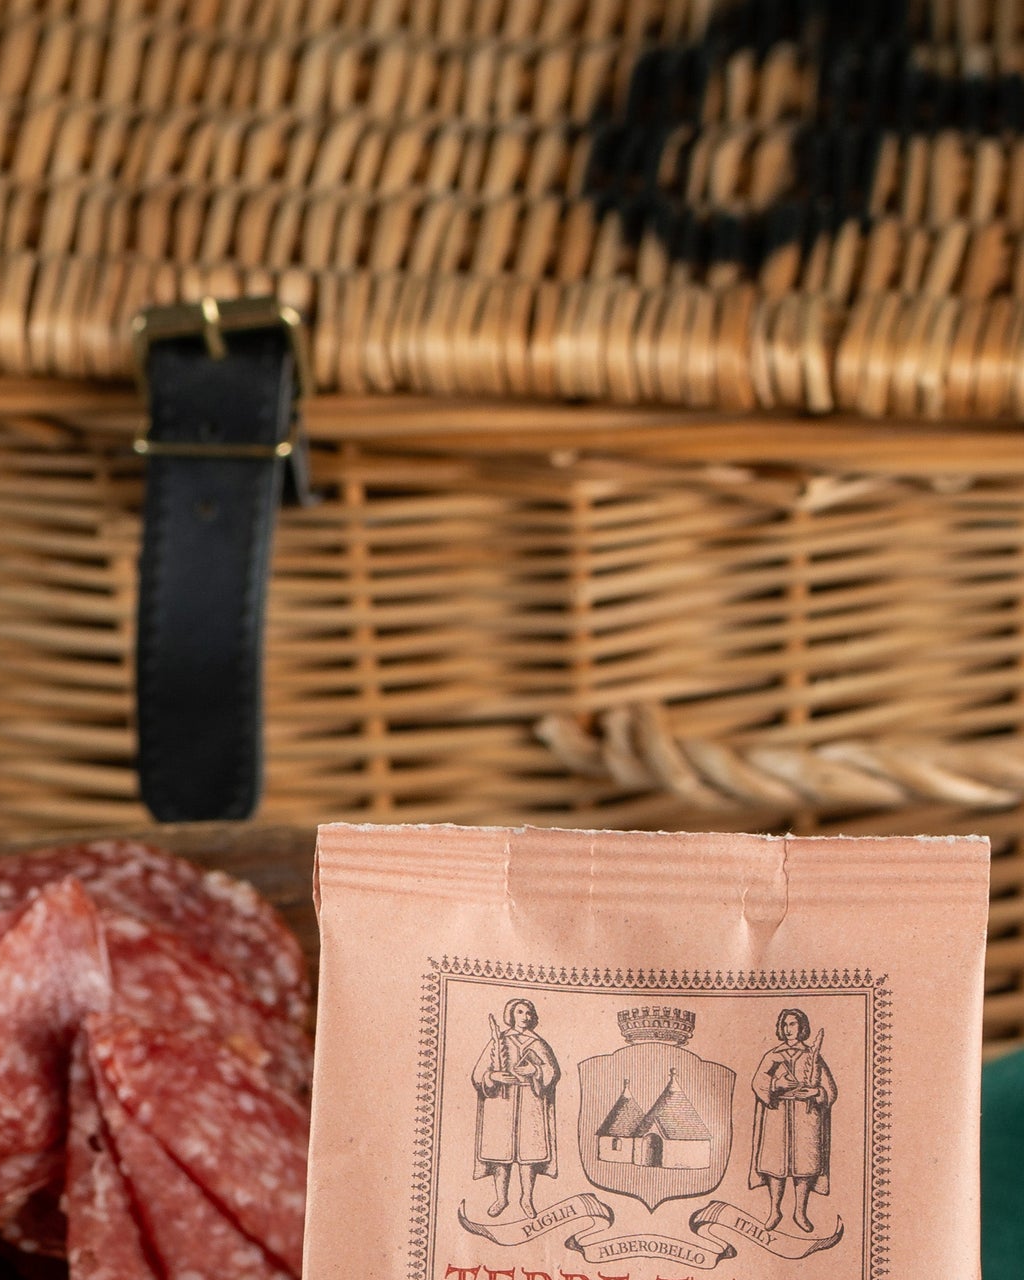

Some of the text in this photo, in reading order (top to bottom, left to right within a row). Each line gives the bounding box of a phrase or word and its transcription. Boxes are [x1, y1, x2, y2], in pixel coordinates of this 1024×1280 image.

[521, 1204, 578, 1238] PUGLIA
[733, 1217, 777, 1247] ITALY
[598, 1239, 706, 1265] ALBEROBELLO
